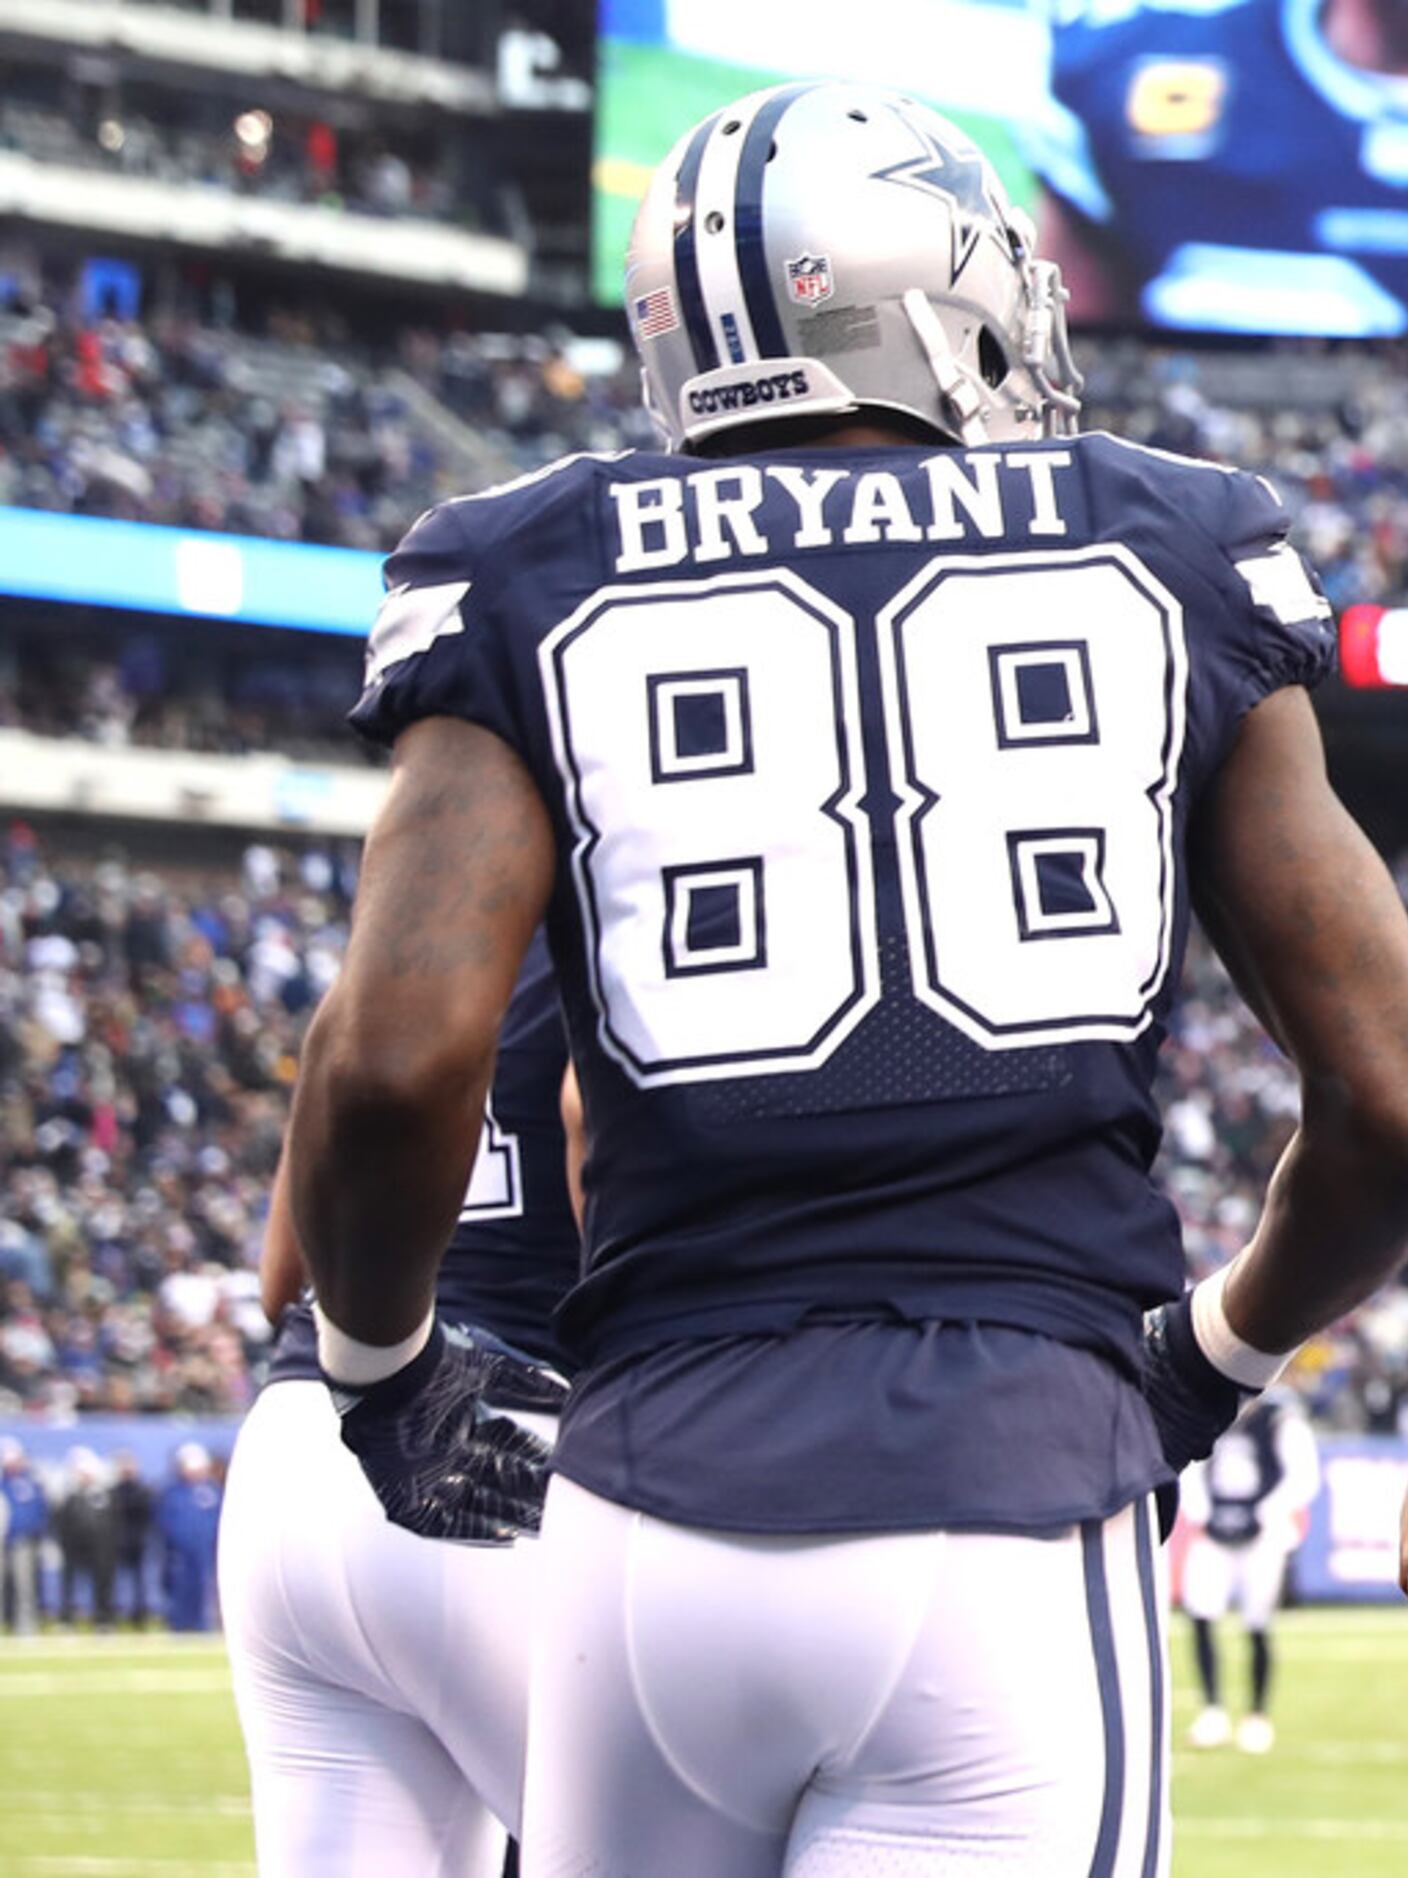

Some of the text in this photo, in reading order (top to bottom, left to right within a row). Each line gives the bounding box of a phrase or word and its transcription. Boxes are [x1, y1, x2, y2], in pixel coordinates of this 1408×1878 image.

[793, 273, 829, 297] NFL
[688, 370, 809, 414] COWBOYS
[608, 449, 1072, 574] BRYANT
[537, 541, 1190, 1090] 88
